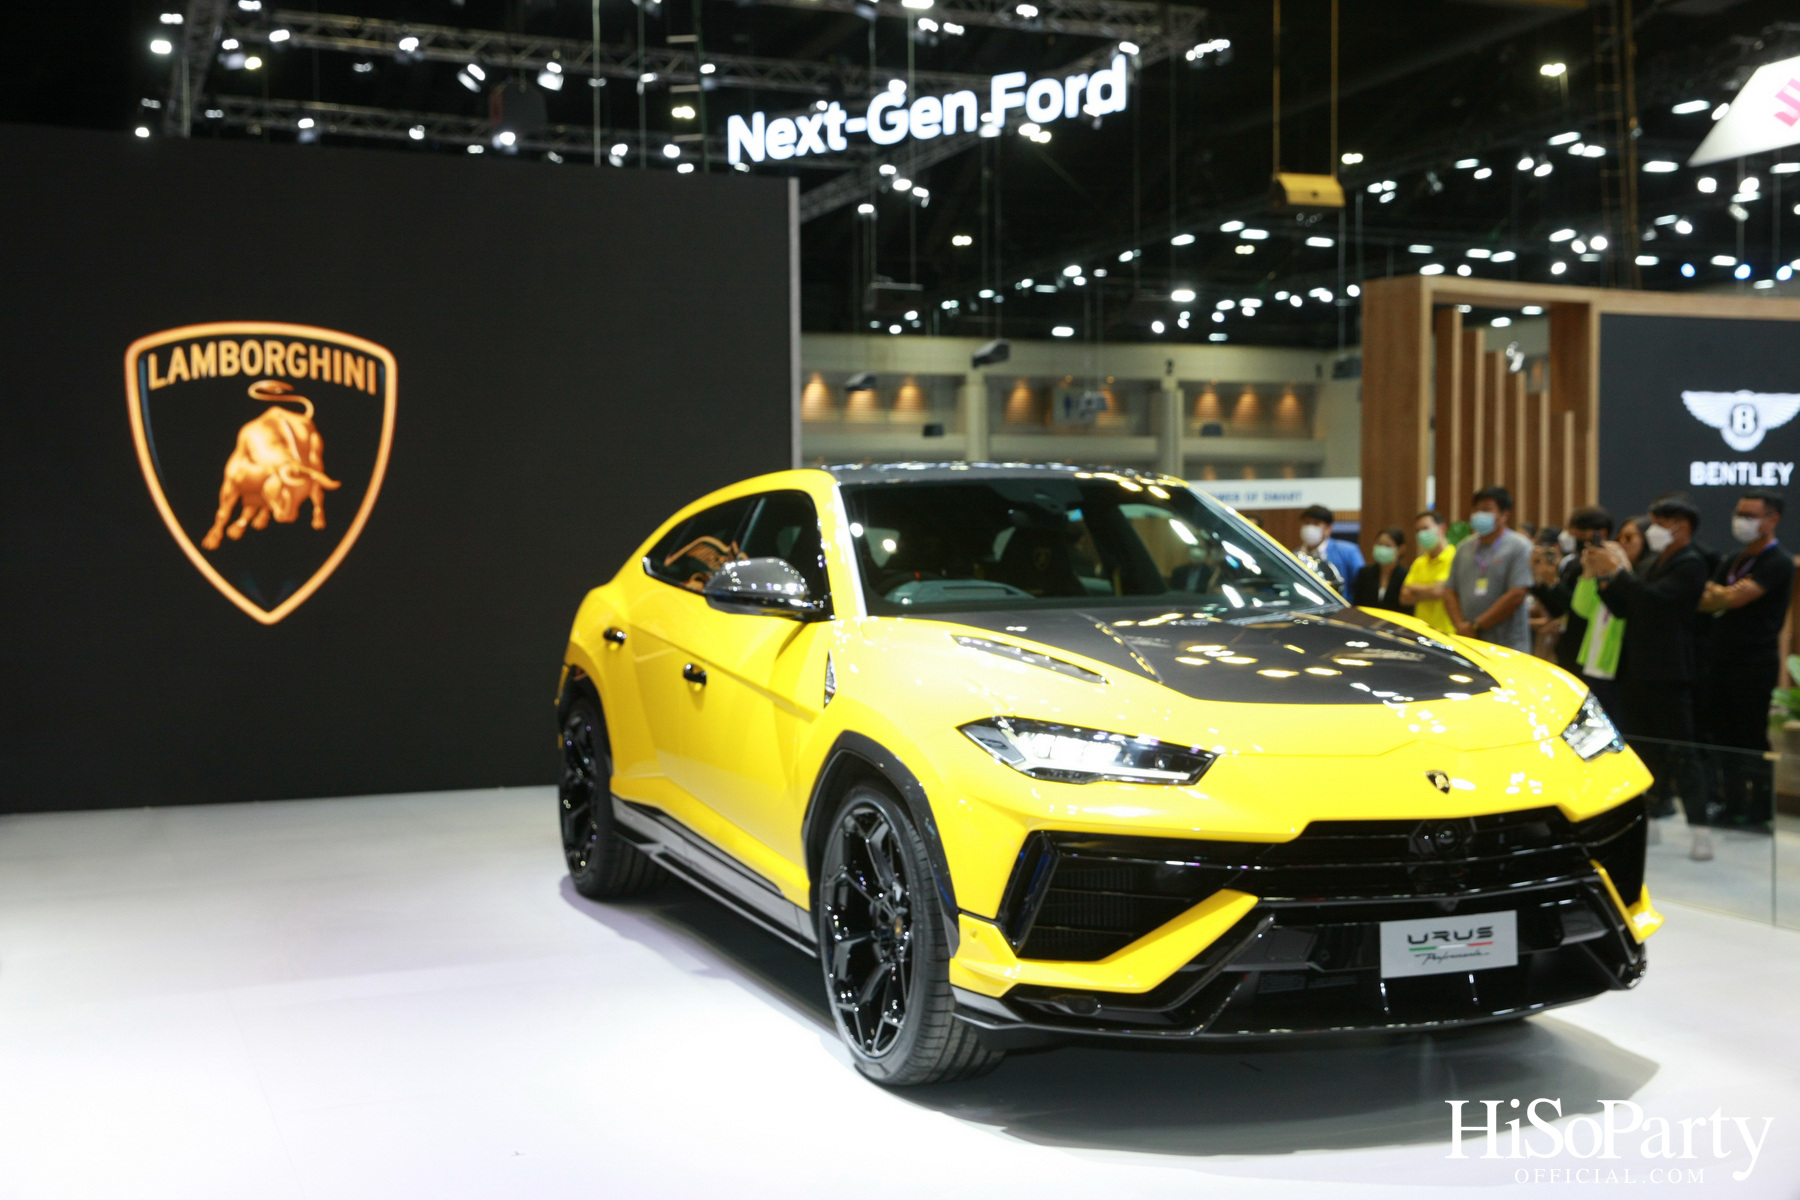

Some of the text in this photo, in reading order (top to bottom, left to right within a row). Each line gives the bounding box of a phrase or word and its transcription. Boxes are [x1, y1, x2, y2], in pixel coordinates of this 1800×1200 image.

[727, 53, 1127, 166] Next-Gen Ford
[148, 339, 377, 396] LAMBORGHINI
[1690, 461, 1795, 486] BENTLEY
[1407, 925, 1494, 945] URUS
